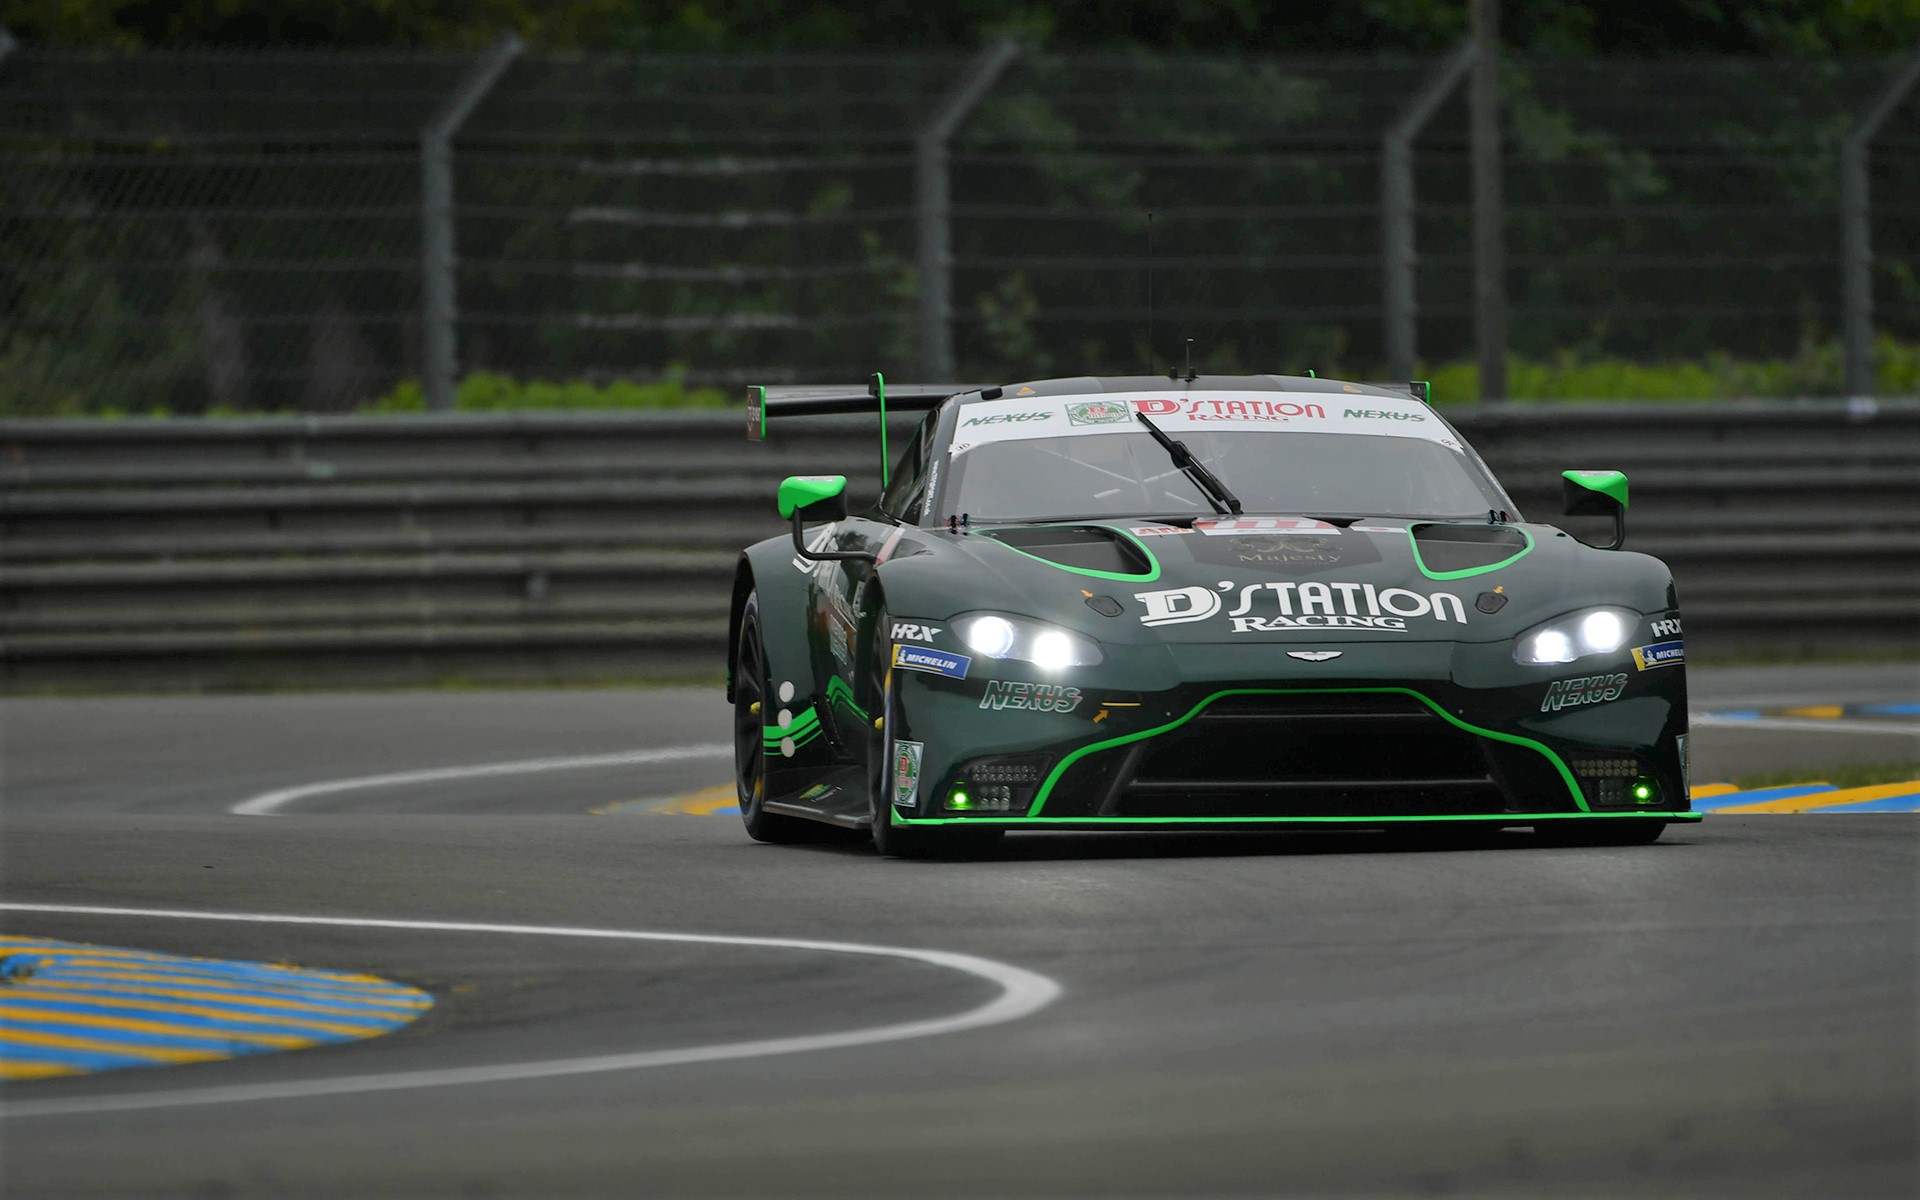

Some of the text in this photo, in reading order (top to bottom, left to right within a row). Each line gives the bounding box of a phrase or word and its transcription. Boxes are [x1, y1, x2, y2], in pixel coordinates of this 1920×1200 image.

[962, 411, 1053, 427] NEXUS
[1188, 414, 1290, 422] RACING
[1343, 409, 1425, 422] NEXUS
[1134, 581, 1467, 627] D'STATION
[1229, 616, 1408, 632] RACING
[890, 623, 943, 643] HRX
[906, 653, 957, 670] MICHELIN
[979, 680, 1083, 713] NEXUS
[1541, 673, 1628, 712] NEXUS
